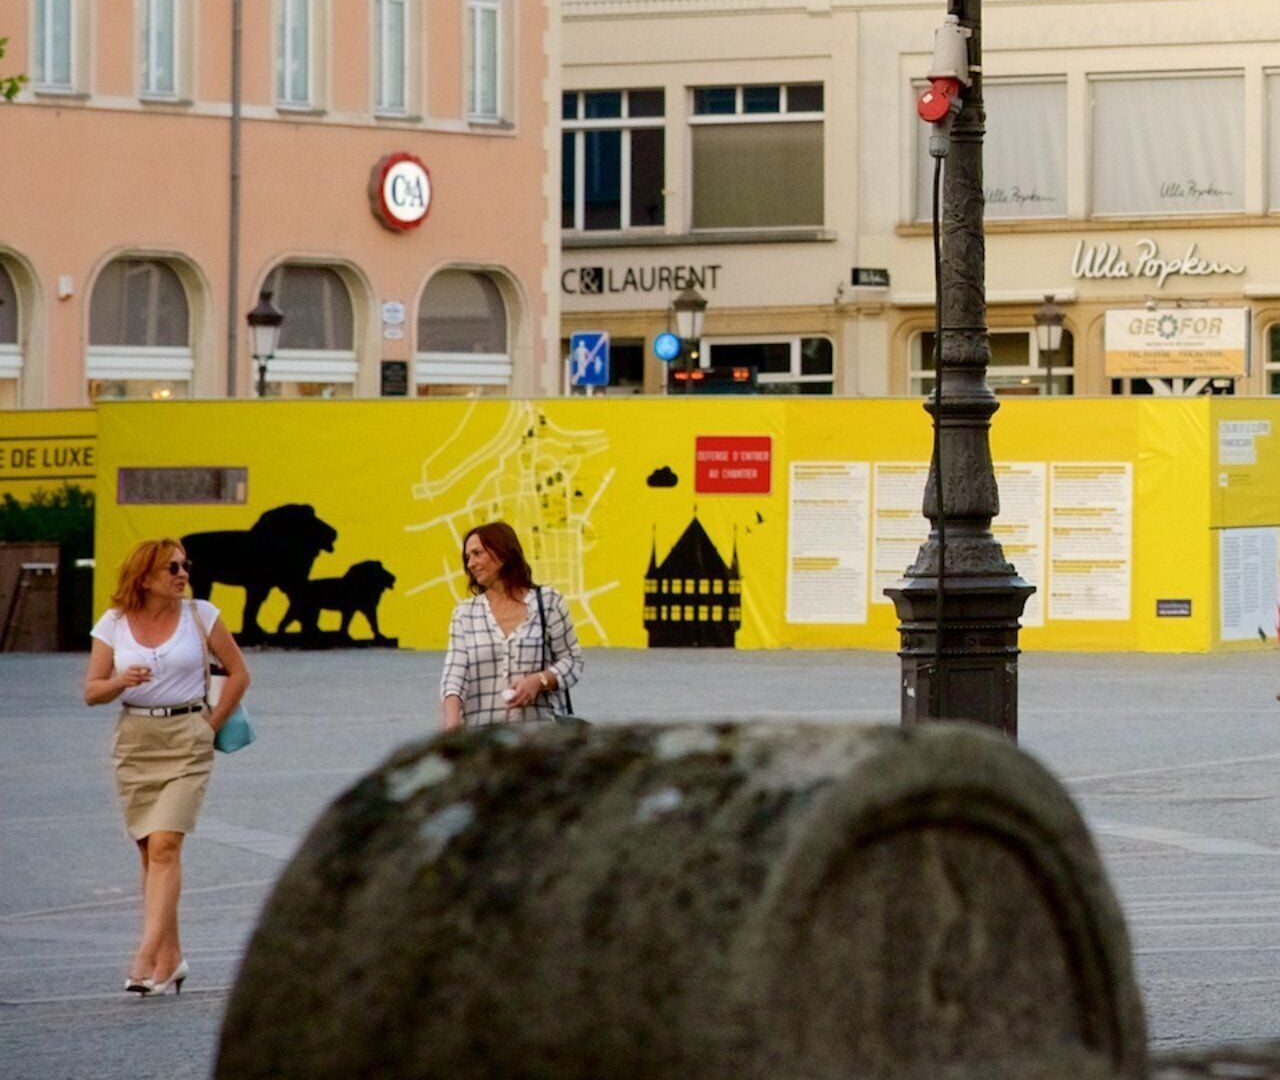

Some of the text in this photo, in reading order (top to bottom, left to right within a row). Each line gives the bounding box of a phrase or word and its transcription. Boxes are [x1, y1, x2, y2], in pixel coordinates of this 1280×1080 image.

[391, 173, 425, 208] C&A
[608, 264, 722, 292] LAURENT
[1071, 238, 1248, 290] Ulla Popken
[1128, 314, 1223, 340] GEOFOR
[11, 448, 37, 469] DE
[42, 447, 95, 468] LUXE
